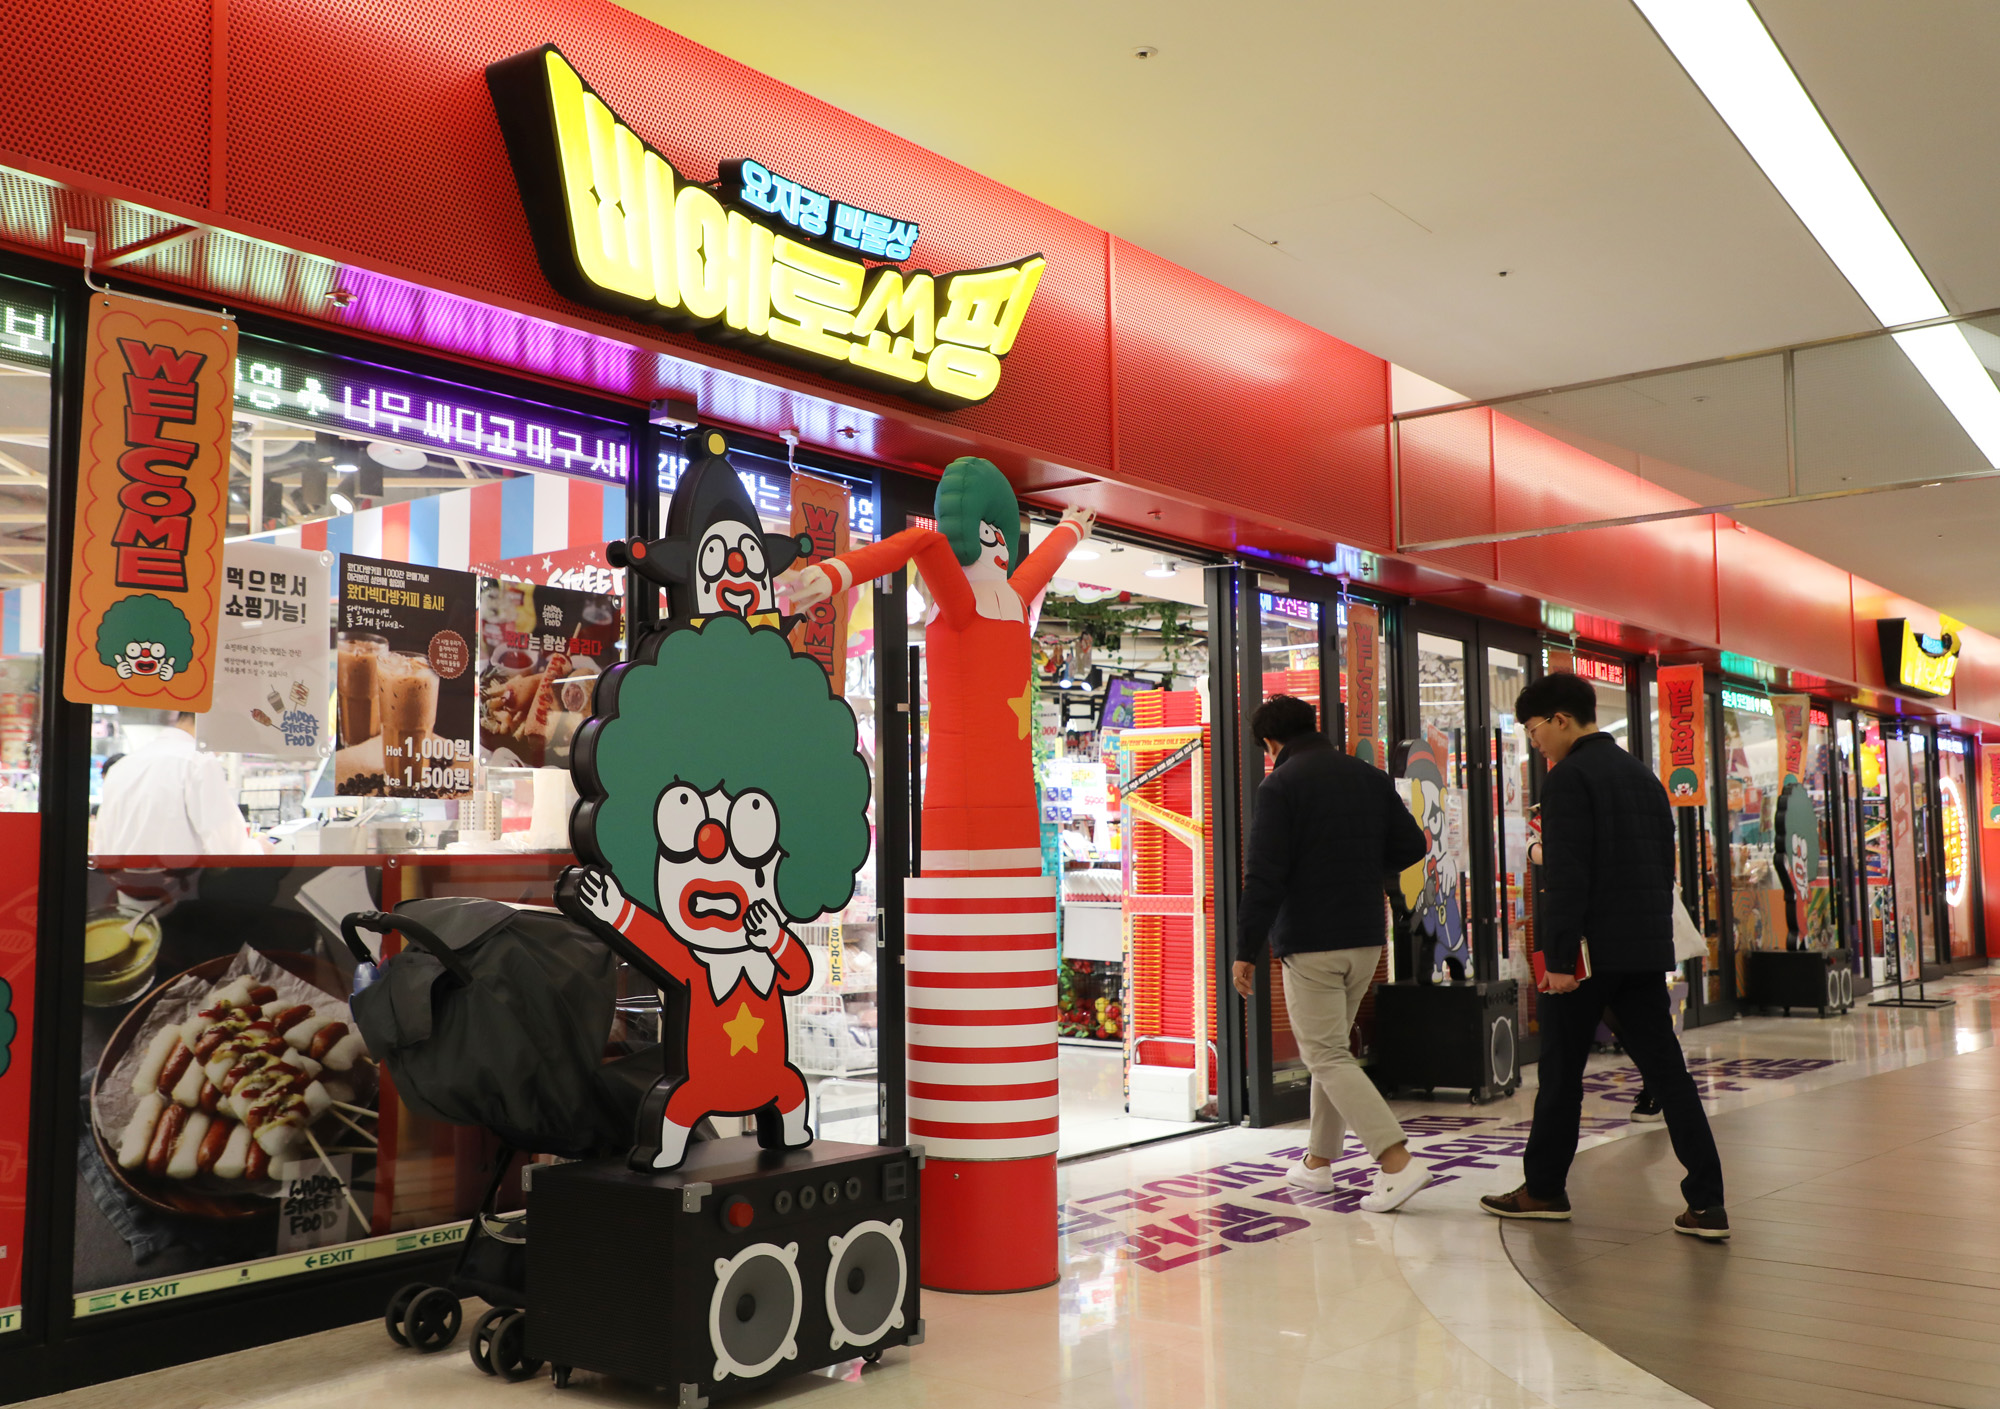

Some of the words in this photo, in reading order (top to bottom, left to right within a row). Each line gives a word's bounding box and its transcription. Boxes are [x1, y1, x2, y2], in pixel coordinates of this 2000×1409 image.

[740, 158, 830, 236] 요지경
[832, 200, 920, 261] 만물상
[545, 50, 1047, 402] 삐에로쑈핑
[345, 386, 412, 432] 너무
[424, 401, 517, 458] 싸다고
[526, 424, 584, 468] 마구
[110, 337, 207, 593] WELCOME
[226, 566, 307, 597] 먹으면서
[801, 502, 840, 676] WEOME
[225, 595, 307, 624] 쇼핑가능!
[347, 583, 420, 608] 왔다빅다방커피
[422, 593, 445, 612] 출시!
[544, 618, 562, 627] FOOD
[505, 631, 541, 651] 왔다는
[543, 634, 567, 653] 항상
[569, 638, 603, 656] 즐겁다
[1353, 622, 1373, 737] WELCOME
[281, 722, 319, 736] STREET
[1665, 679, 1696, 766] WELCOME
[284, 734, 315, 747] FOOD
[386, 745, 402, 757] Hot
[404, 736, 470, 762] 1,000원
[385, 775, 400, 786] Ice
[404, 766, 470, 791] 1,500원
[284, 1194, 343, 1218] STREET
[290, 1209, 337, 1235] FOOD
[432, 1227, 465, 1244] EXIT
[319, 1248, 355, 1266] EXIT
[138, 1282, 180, 1302] EXIT
